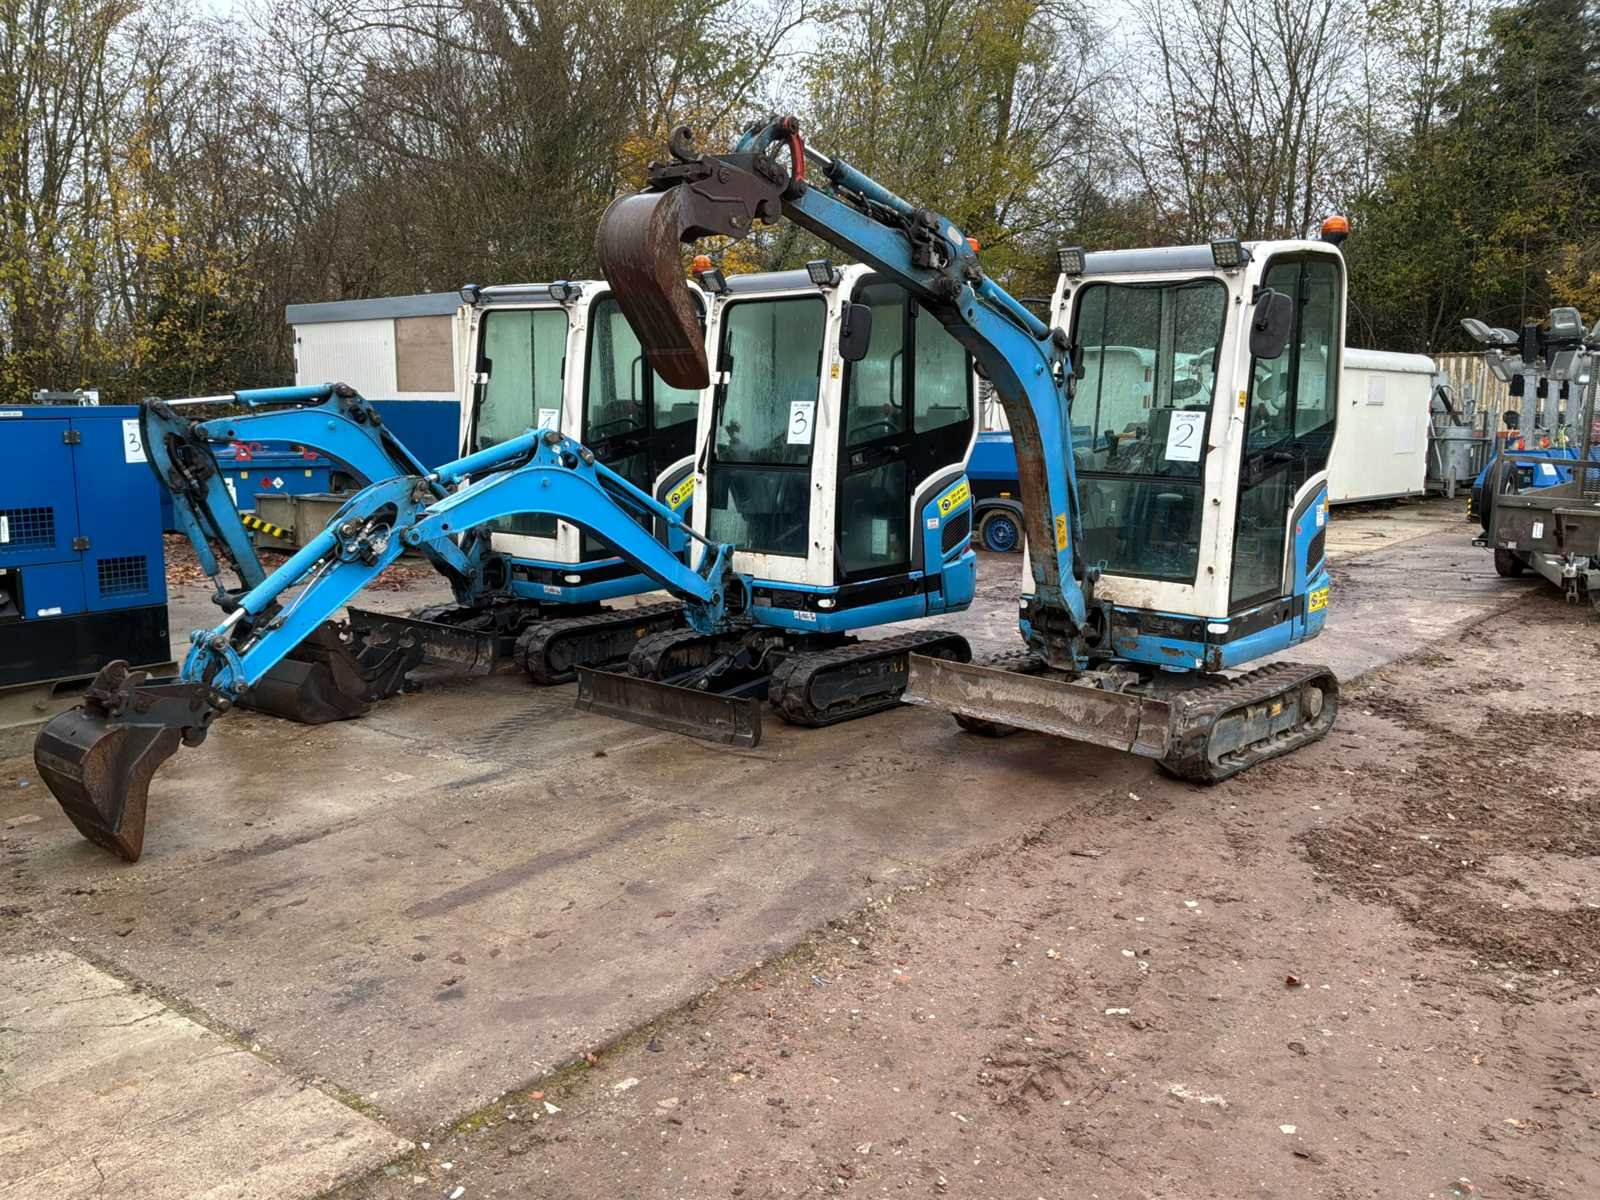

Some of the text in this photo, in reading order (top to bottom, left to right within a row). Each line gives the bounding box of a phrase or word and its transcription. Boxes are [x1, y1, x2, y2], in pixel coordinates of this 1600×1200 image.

[792, 411, 808, 435] 3
[128, 433, 142, 453] 3
[1174, 423, 1194, 449] 2
